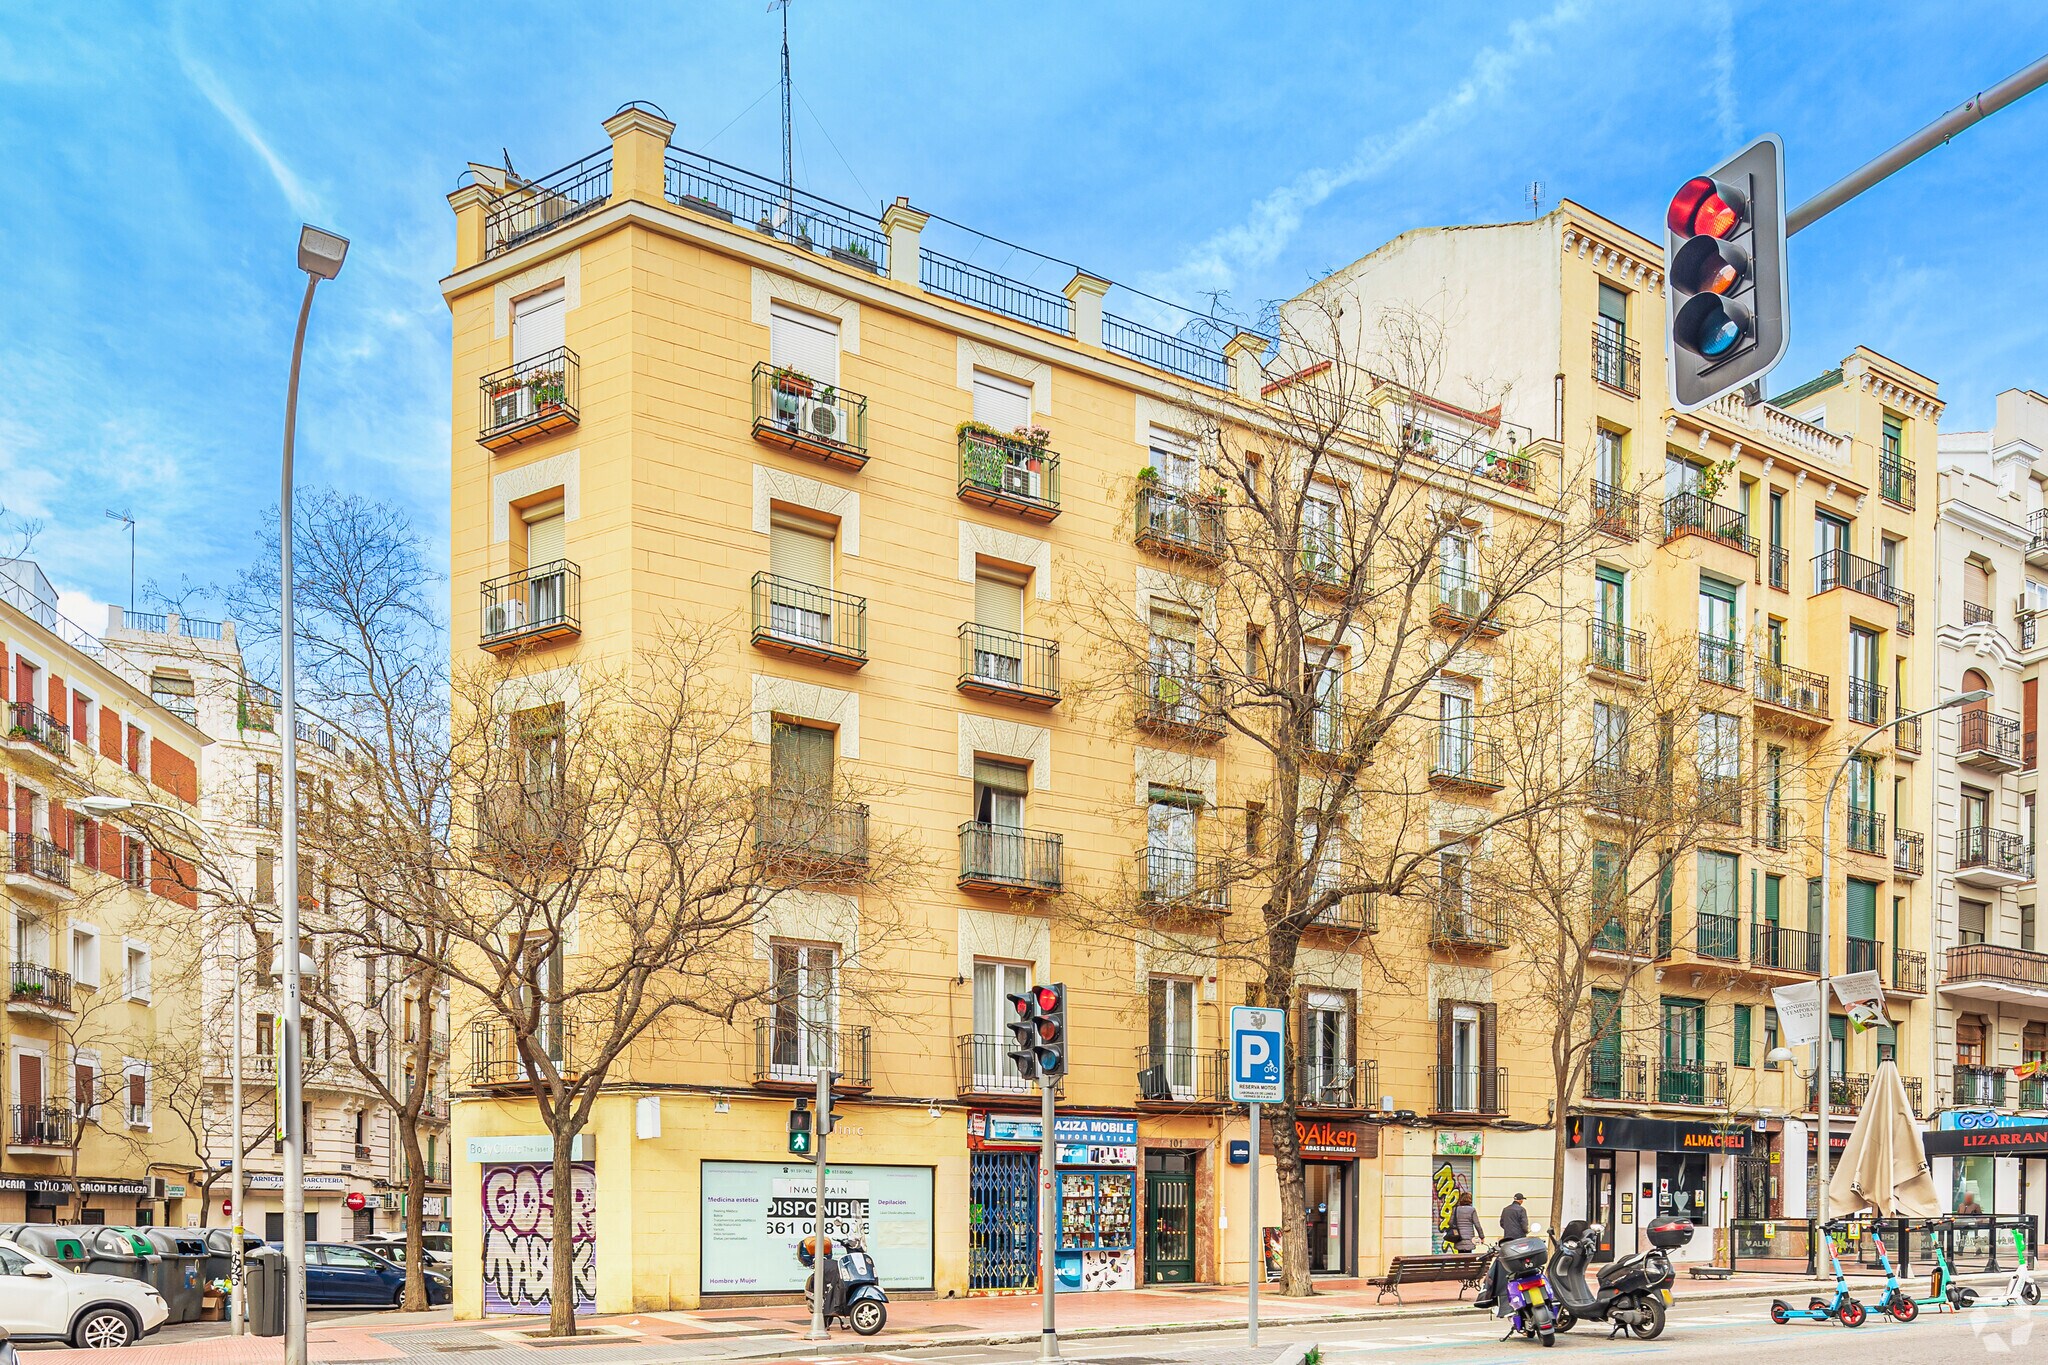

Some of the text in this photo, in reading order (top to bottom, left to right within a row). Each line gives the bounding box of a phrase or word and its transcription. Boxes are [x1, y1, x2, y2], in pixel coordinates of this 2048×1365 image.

[1241, 1035, 1270, 1078] P
[1055, 1121, 1088, 1132] AZIZA
[1091, 1121, 1134, 1134] MOBILE
[1055, 1133, 1132, 1142] INFORMÁTICA
[1303, 1122, 1357, 1147] Aiken
[1963, 1131, 2048, 1147] LIZARRAN
[1169, 1139, 1183, 1148] 101
[34, 1180, 59, 1192] STYLO
[80, 1184, 106, 1193] SALON
[107, 1185, 117, 1193] DE
[119, 1185, 148, 1194] BELLEZA
[789, 1186, 848, 1194] INMOPAIN
